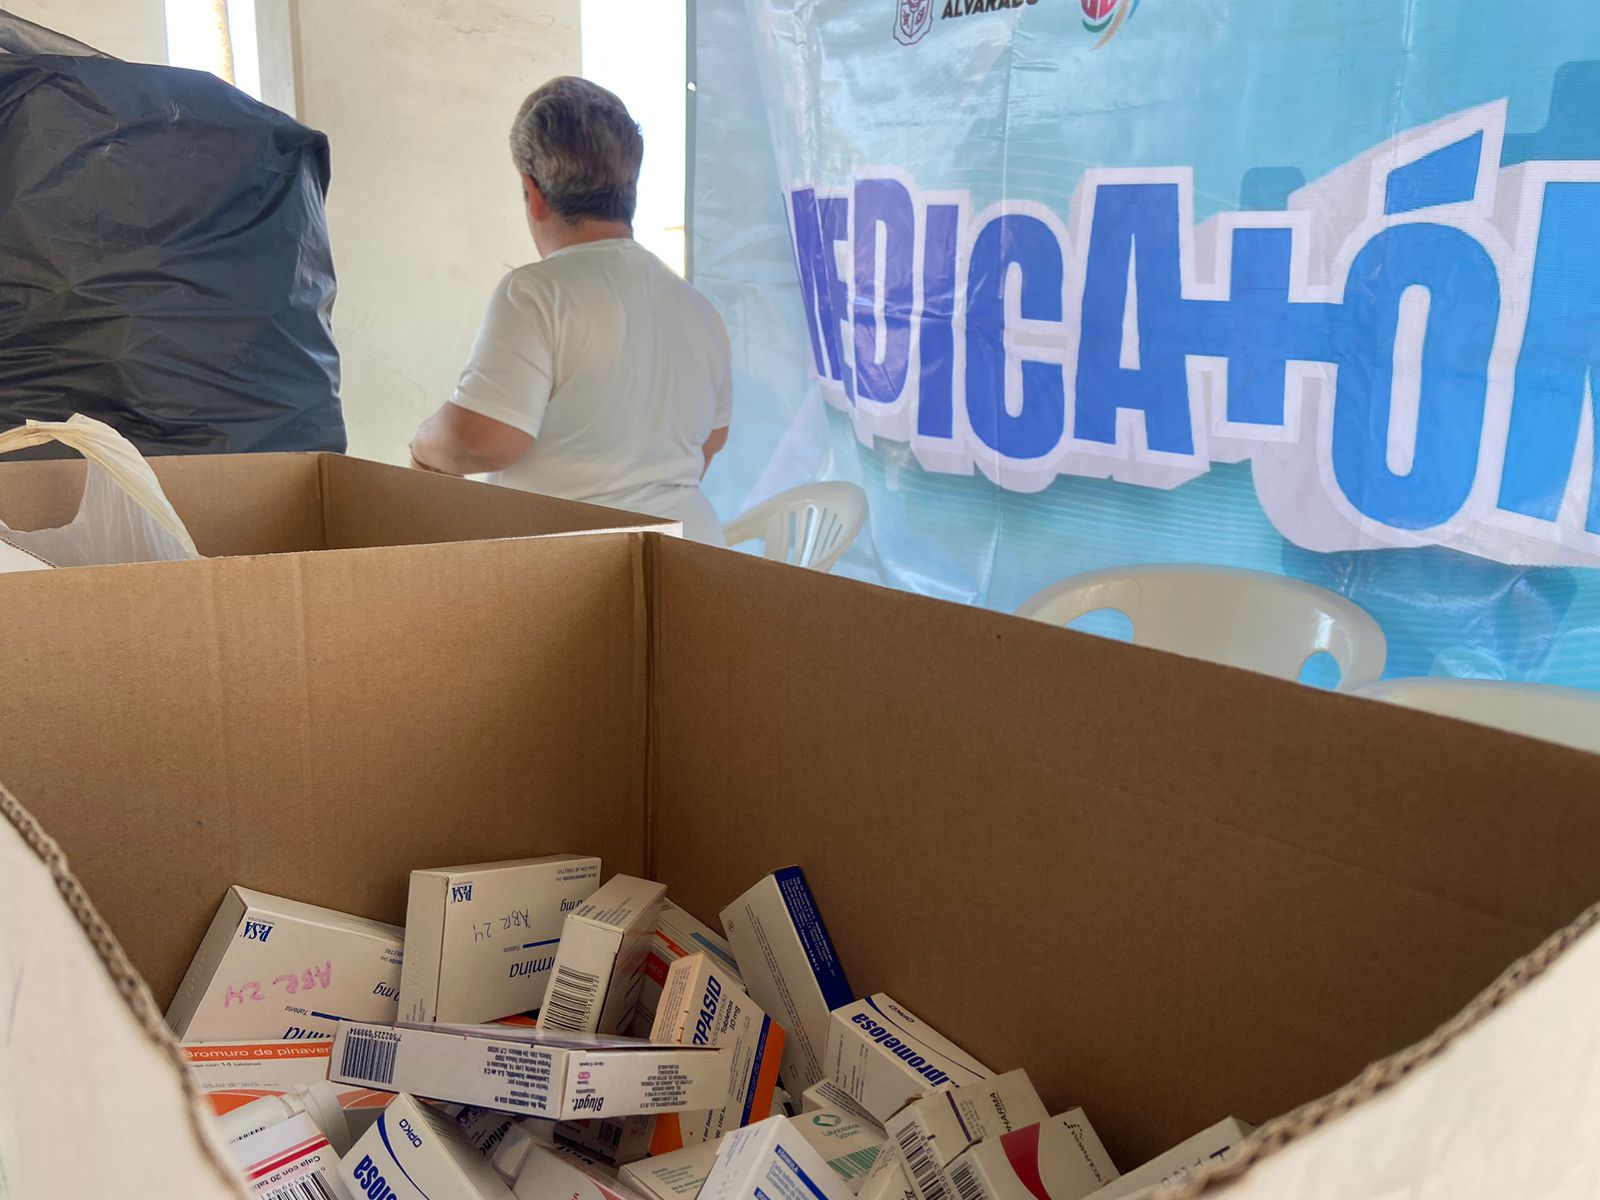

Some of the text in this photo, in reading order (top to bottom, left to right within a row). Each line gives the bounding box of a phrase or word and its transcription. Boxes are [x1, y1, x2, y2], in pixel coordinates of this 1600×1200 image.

[941, 0, 1038, 19] ALVARA
[560, 898, 575, 912] mg
[373, 981, 395, 998] mg
[720, 1000, 734, 1035] Tabletas
[728, 1004, 741, 1030] 10 mg
[254, 1046, 273, 1056] de
[851, 1013, 960, 1088] ipromelosa
[398, 1118, 422, 1148] OPKO
[269, 1172, 282, 1184] 20
[281, 1164, 300, 1177] con
